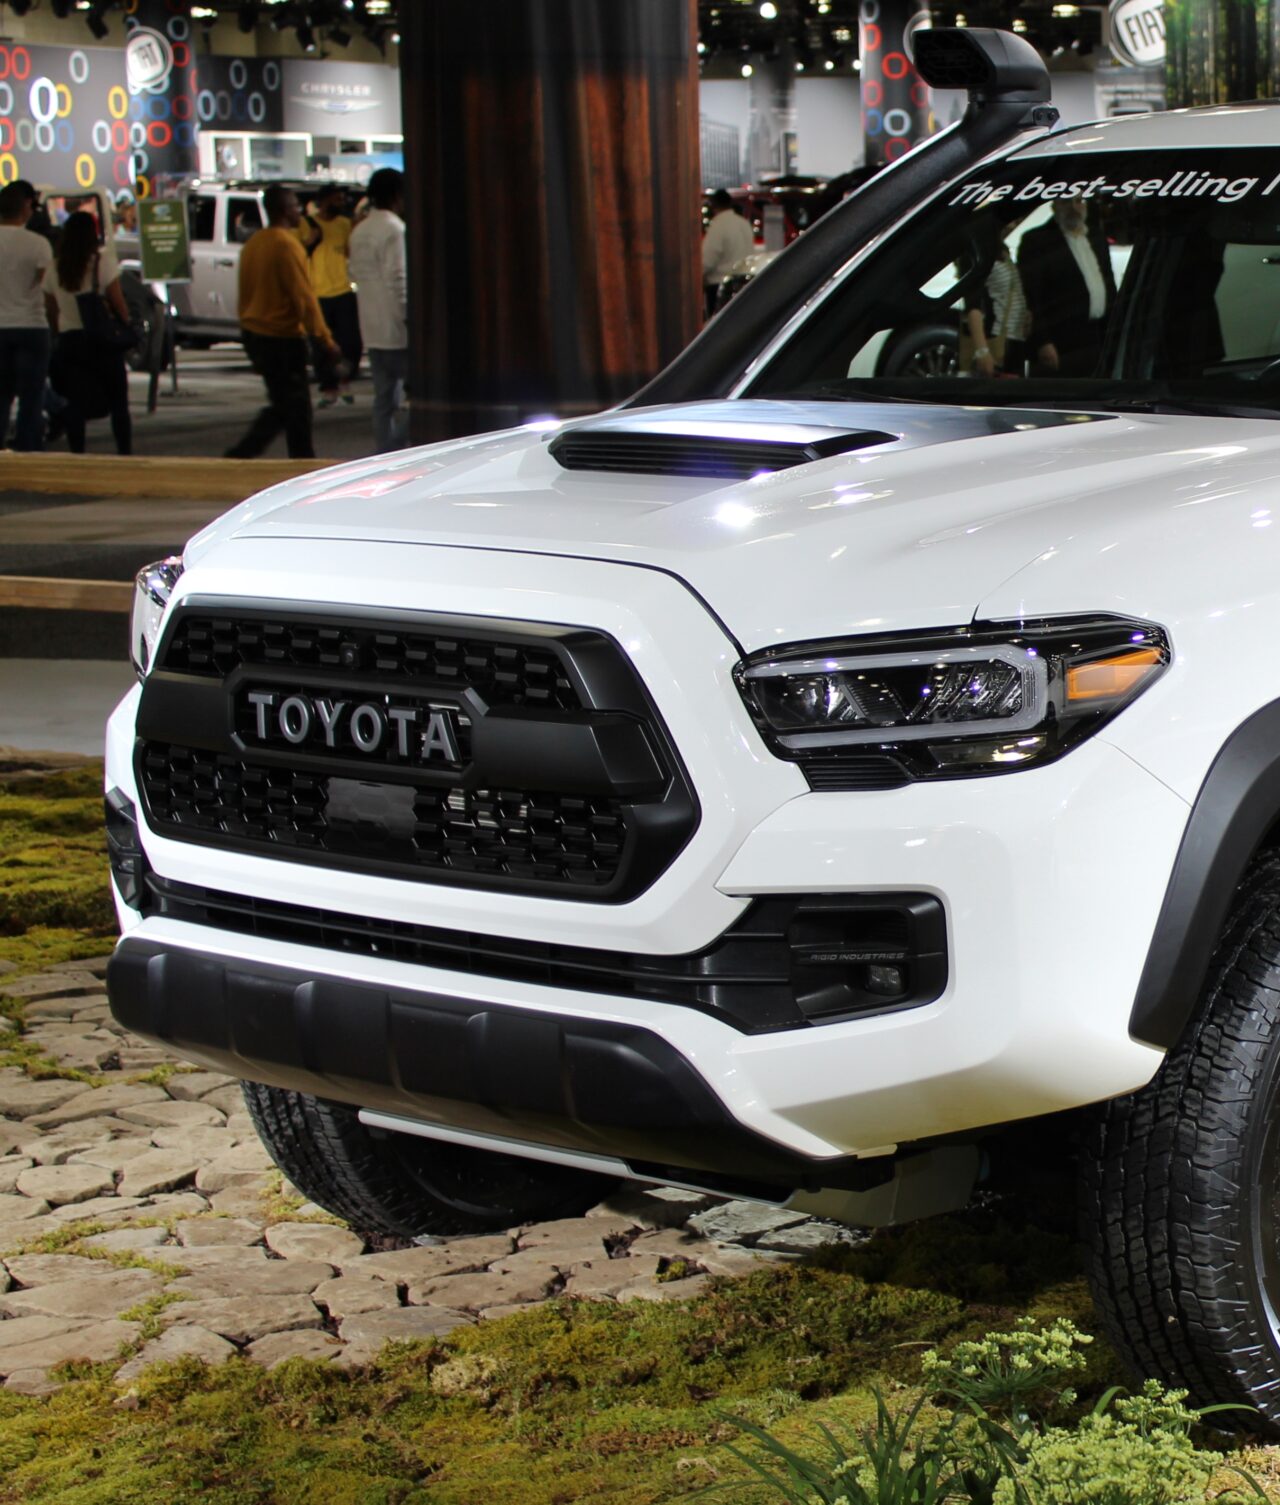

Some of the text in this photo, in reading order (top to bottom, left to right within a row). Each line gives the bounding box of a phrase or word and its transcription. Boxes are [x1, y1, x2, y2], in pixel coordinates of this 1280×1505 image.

[301, 82, 371, 96] CHRYSLER
[948, 179, 1014, 211] The
[1013, 171, 1260, 202] best-selling
[248, 691, 460, 763] TOYOTA
[810, 952, 905, 961] RIGID INDUSTRIES
